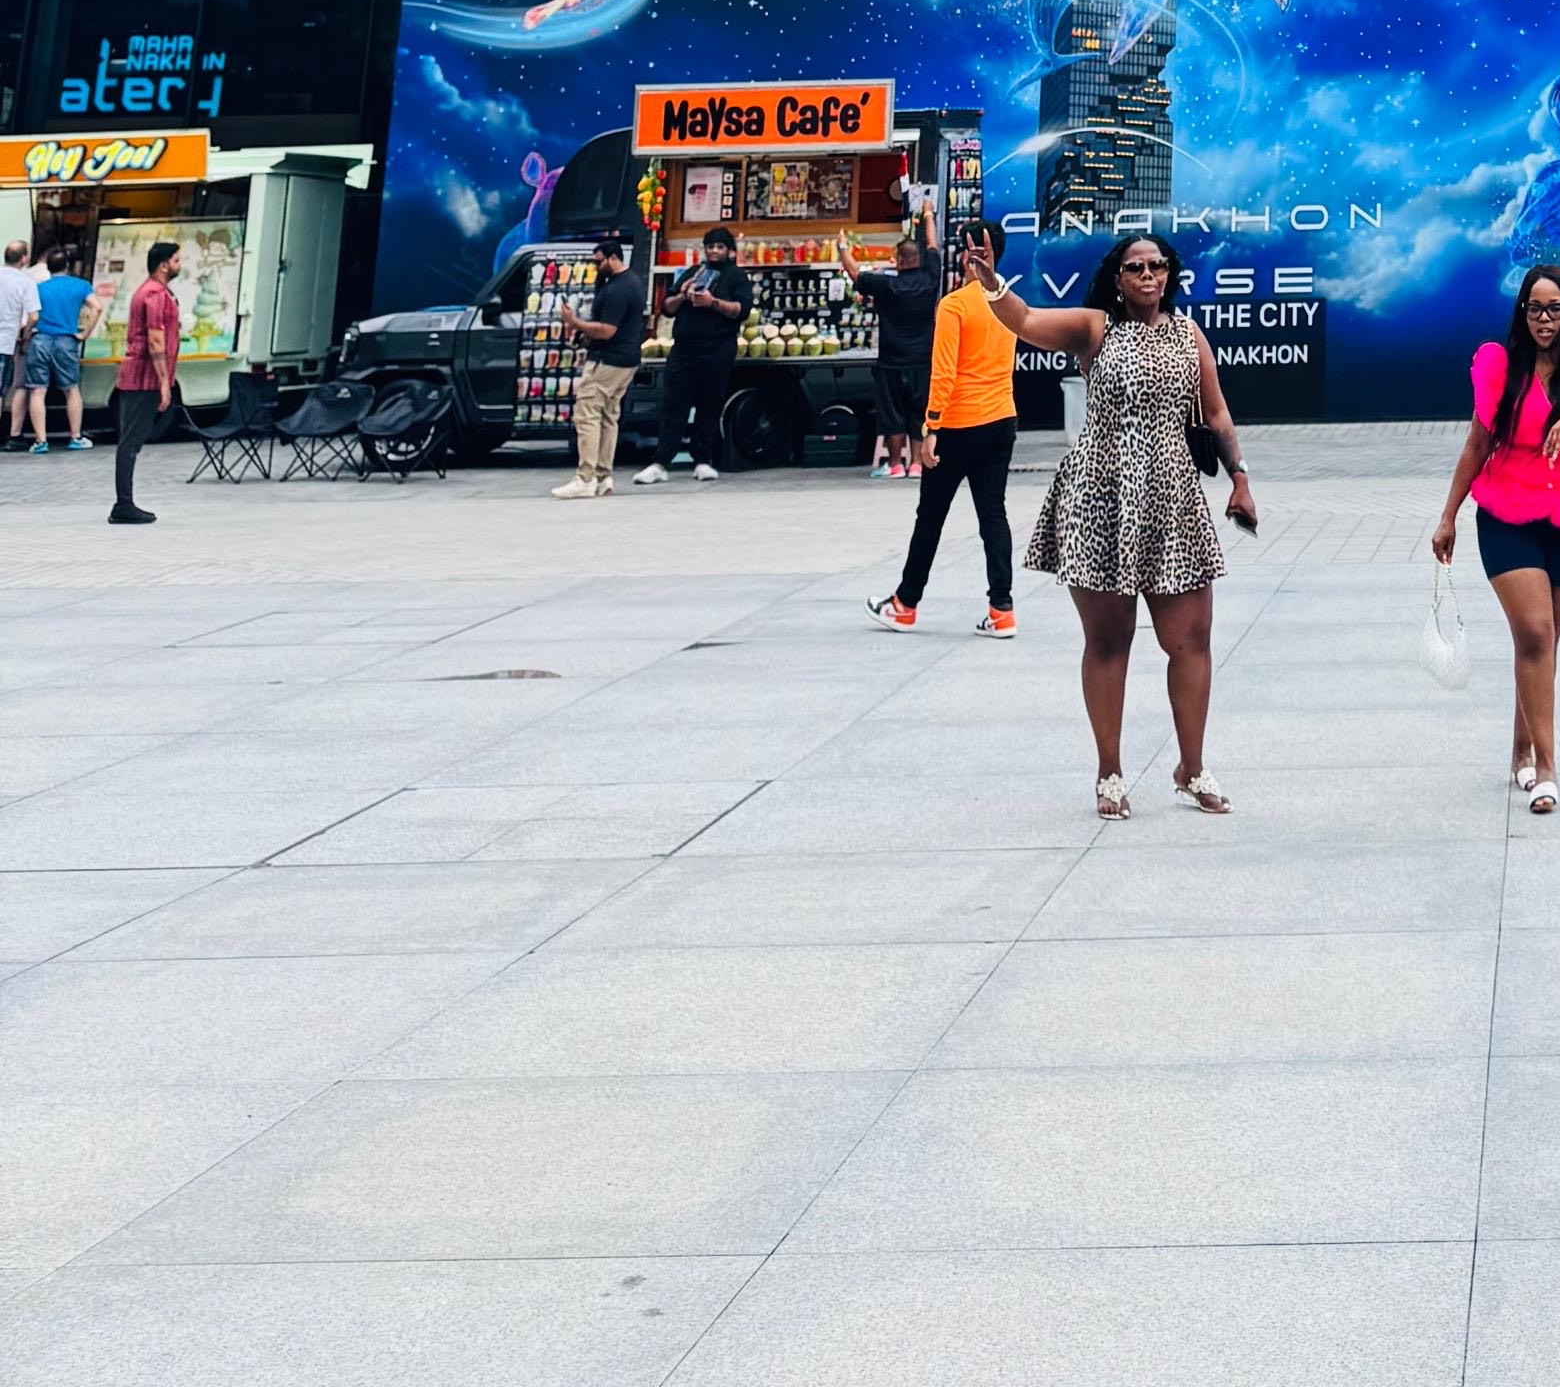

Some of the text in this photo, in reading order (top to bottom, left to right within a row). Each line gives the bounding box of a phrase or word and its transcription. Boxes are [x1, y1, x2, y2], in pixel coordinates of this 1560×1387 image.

[128, 35, 194, 53] MAHA
[126, 52, 226, 71] NAKHN
[1200, 303, 1252, 329] THE
[1259, 301, 1319, 327] CITY
[1015, 351, 1067, 372] KING
